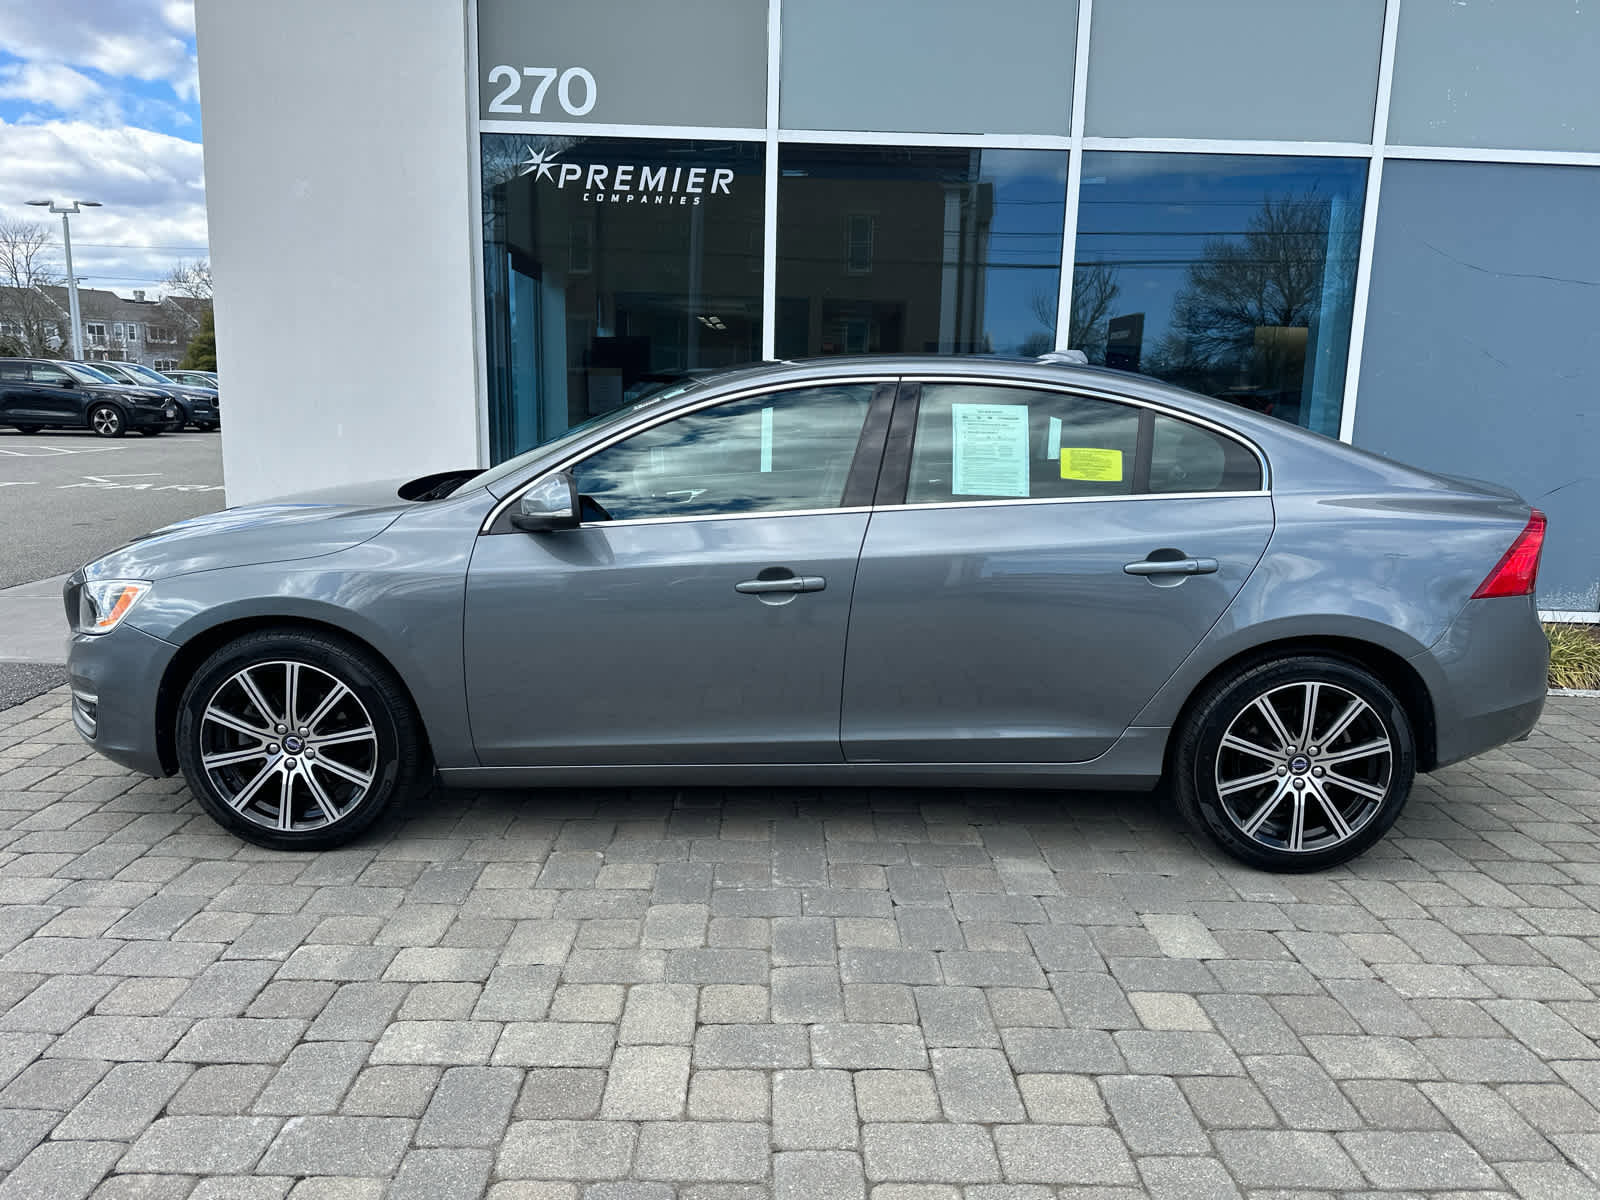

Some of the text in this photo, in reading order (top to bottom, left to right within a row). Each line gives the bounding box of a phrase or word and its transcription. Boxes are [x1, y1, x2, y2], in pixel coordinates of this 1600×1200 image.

[488, 65, 597, 116] 270
[557, 163, 734, 194] PREMIER
[583, 192, 702, 206] COMPANIES
